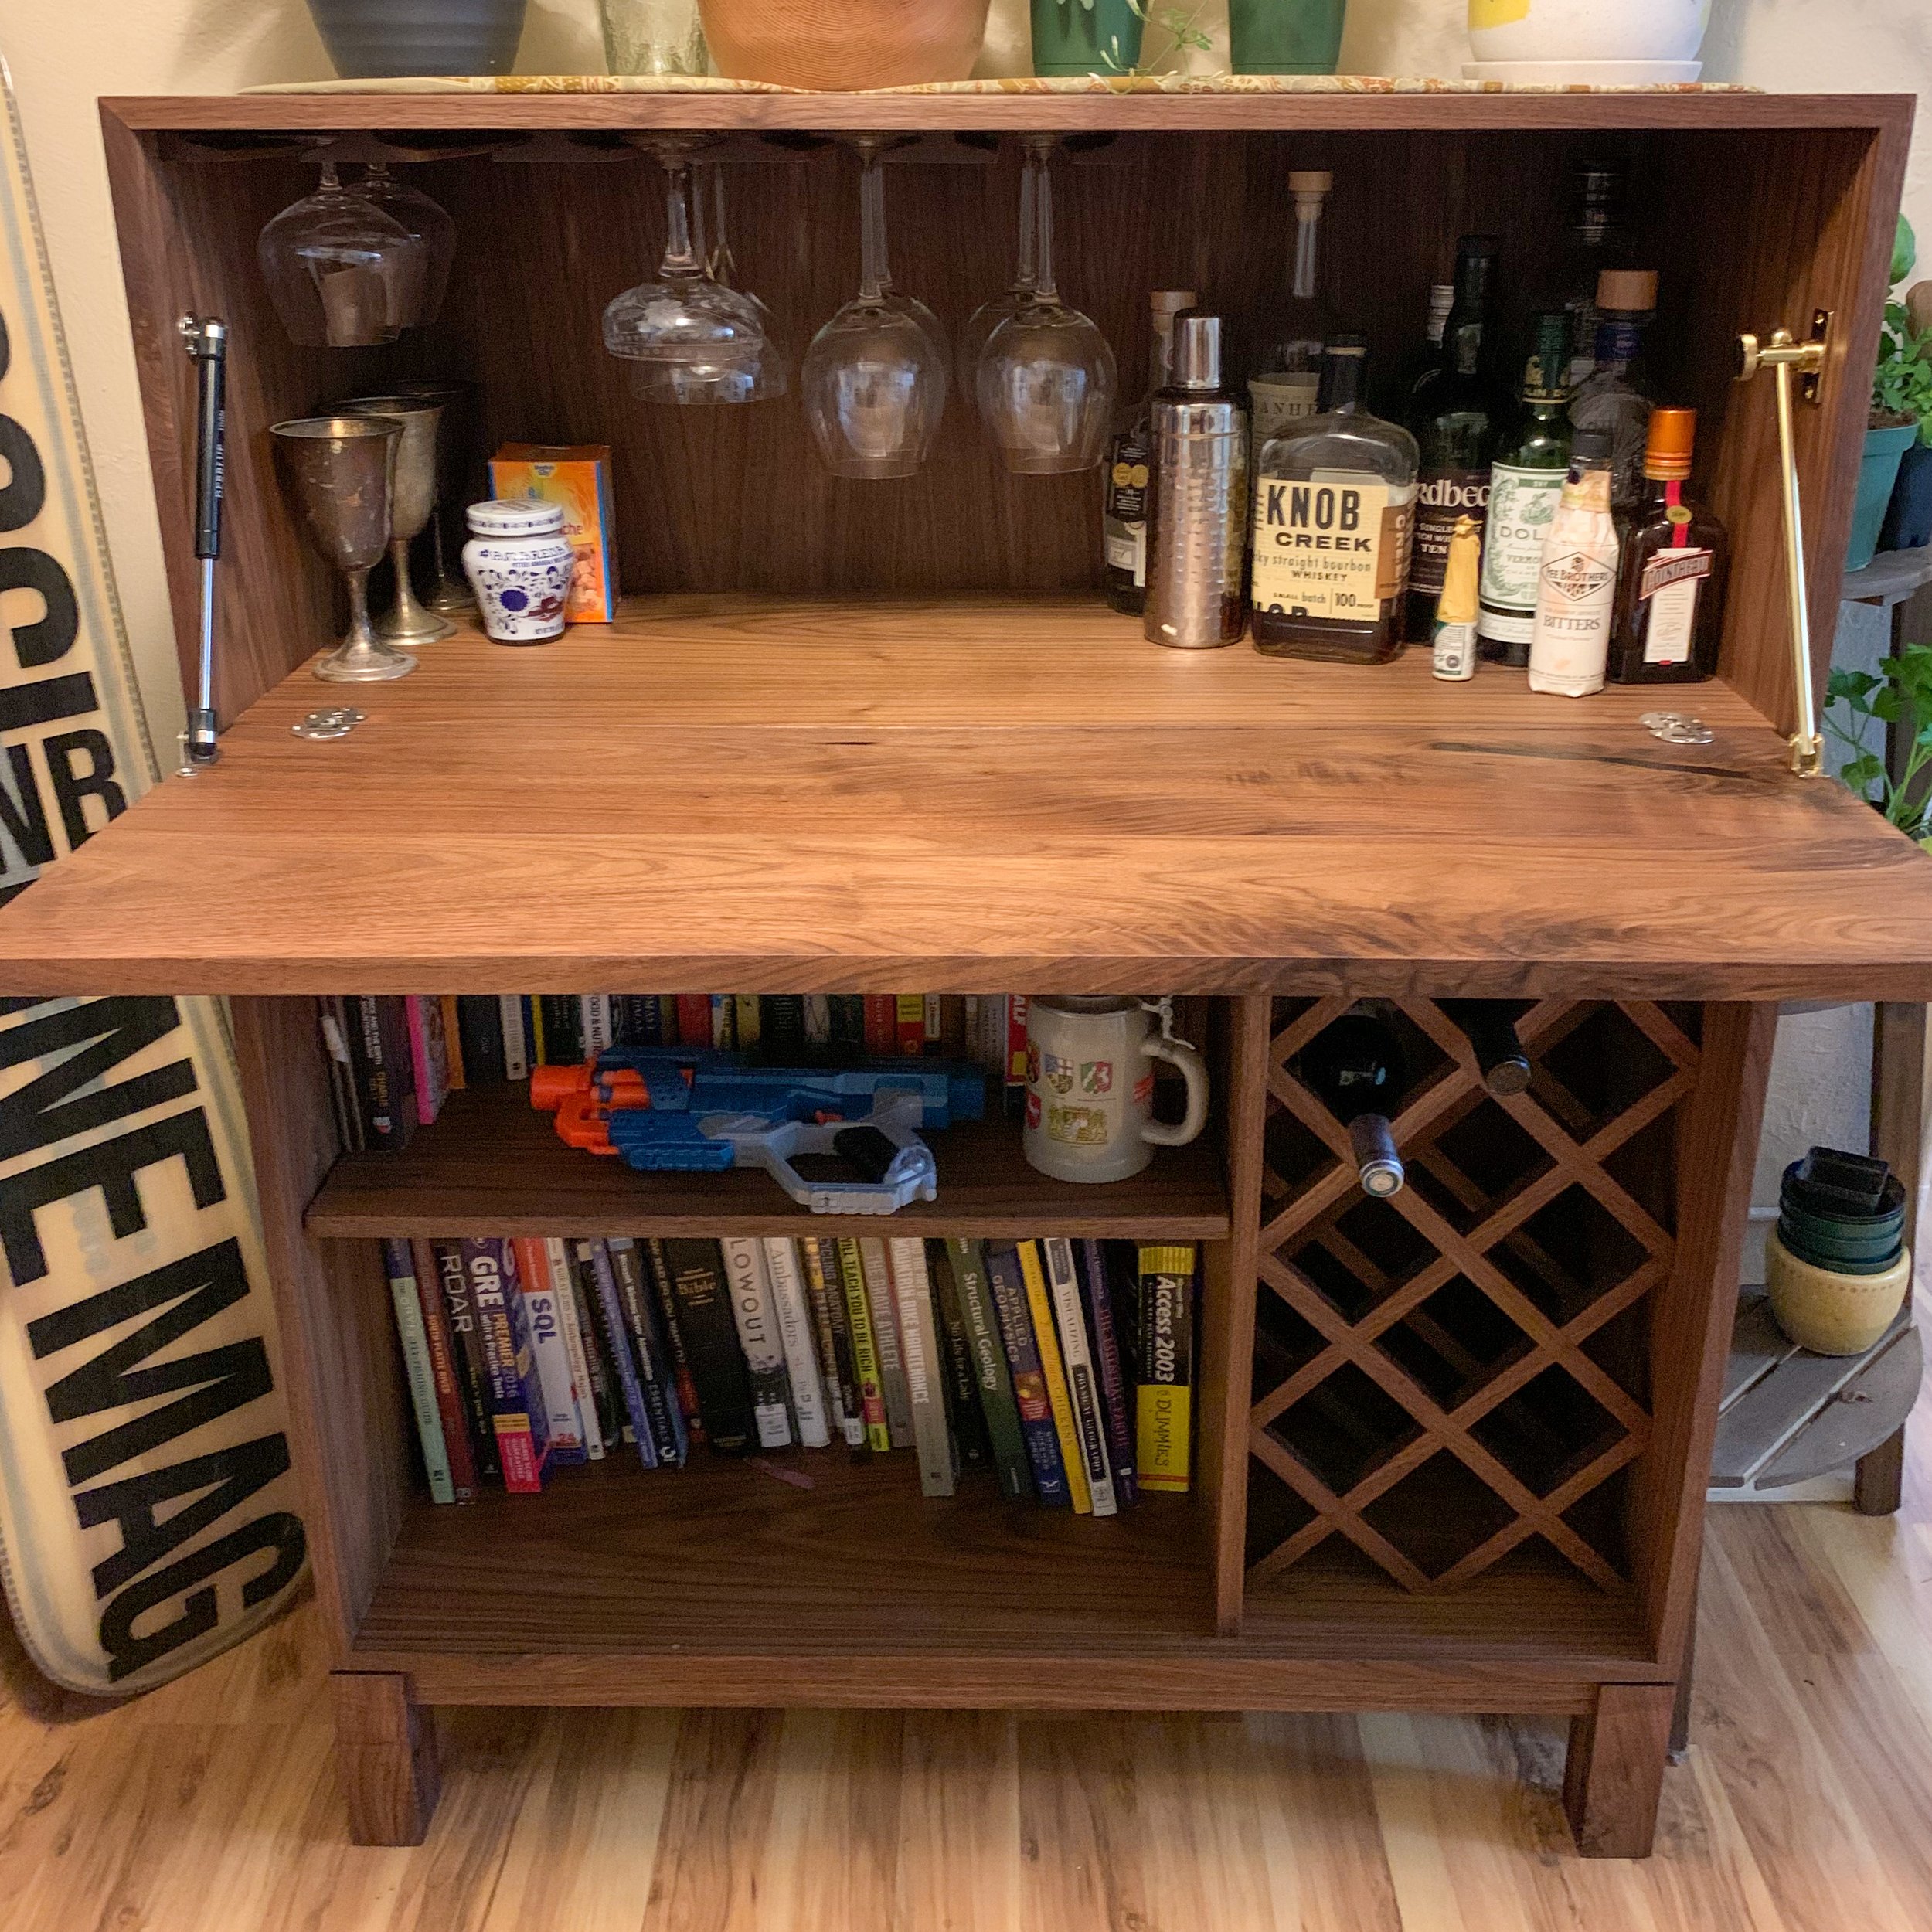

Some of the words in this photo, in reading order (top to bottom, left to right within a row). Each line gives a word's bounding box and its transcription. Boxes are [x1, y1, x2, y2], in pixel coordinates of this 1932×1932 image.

[1267, 485, 1360, 531] KNOB
[1275, 532, 1372, 553] CREEK
[1420, 543, 1448, 554] TEN
[1499, 526, 1544, 541] DOL
[1271, 554, 1319, 571] straight
[1322, 557, 1372, 573] bourbon
[1291, 570, 1349, 582] WHISKEY
[1506, 554, 1540, 564] VERMO
[1301, 590, 1328, 605] batch
[1335, 592, 1357, 607] 100
[1543, 614, 1601, 631] BITTERS
[654, 1259, 666, 1278] BAD
[820, 1238, 836, 1280] CYCLING
[845, 1261, 861, 1293] TEACH
[866, 1253, 881, 1277] THE
[893, 1240, 916, 1297] MOUNTAIN
[440, 1255, 474, 1333] ROAR
[469, 1256, 505, 1308] GRE
[659, 1281, 671, 1296] DO
[730, 1240, 766, 1345] LOWOUT
[770, 1249, 800, 1347] Ambassadors
[871, 1280, 890, 1318] BRAVE
[532, 1298, 556, 1344] SQL
[664, 1298, 675, 1317] YOU
[826, 1284, 845, 1334] ANATOMY
[851, 1295, 866, 1315] YOU
[902, 1301, 919, 1327] BIKE
[992, 1274, 1019, 1362] GEOPHYSICS
[1008, 1287, 1029, 1347] APPLIED
[1154, 1277, 1176, 1334] Access
[492, 1313, 515, 1367] PREMIER
[668, 1321, 682, 1347] WANT
[853, 1318, 866, 1330] TO
[855, 1333, 869, 1344] BE
[964, 1272, 985, 1335] Structural
[979, 1339, 1000, 1391] Geology
[1061, 1291, 1081, 1358] VISUALIZING
[485, 1342, 501, 1376] Practice
[565, 1323, 583, 1372] Anthropology
[857, 1349, 873, 1372] RICH
[876, 1320, 900, 1371] ATHLETE
[951, 1338, 965, 1355] Life
[1155, 1337, 1175, 1383] 2003
[436, 1372, 451, 1394] RIVER
[907, 1329, 929, 1404] MAINTENANCE
[492, 1377, 505, 1400] Tests
[573, 1374, 587, 1400] Majors
[956, 1379, 971, 1400] Lady
[1076, 1372, 1094, 1416] PHYSICAL
[1102, 1335, 1121, 1401] ESSENTIAL
[1114, 1406, 1129, 1447] EARTH
[648, 1384, 671, 1443] ESSENTIALS
[1052, 1387, 1074, 1446] CHICKENS
[1083, 1418, 1102, 1475] GEOGRAPHY
[1155, 1400, 1173, 1467] DUMMIES
